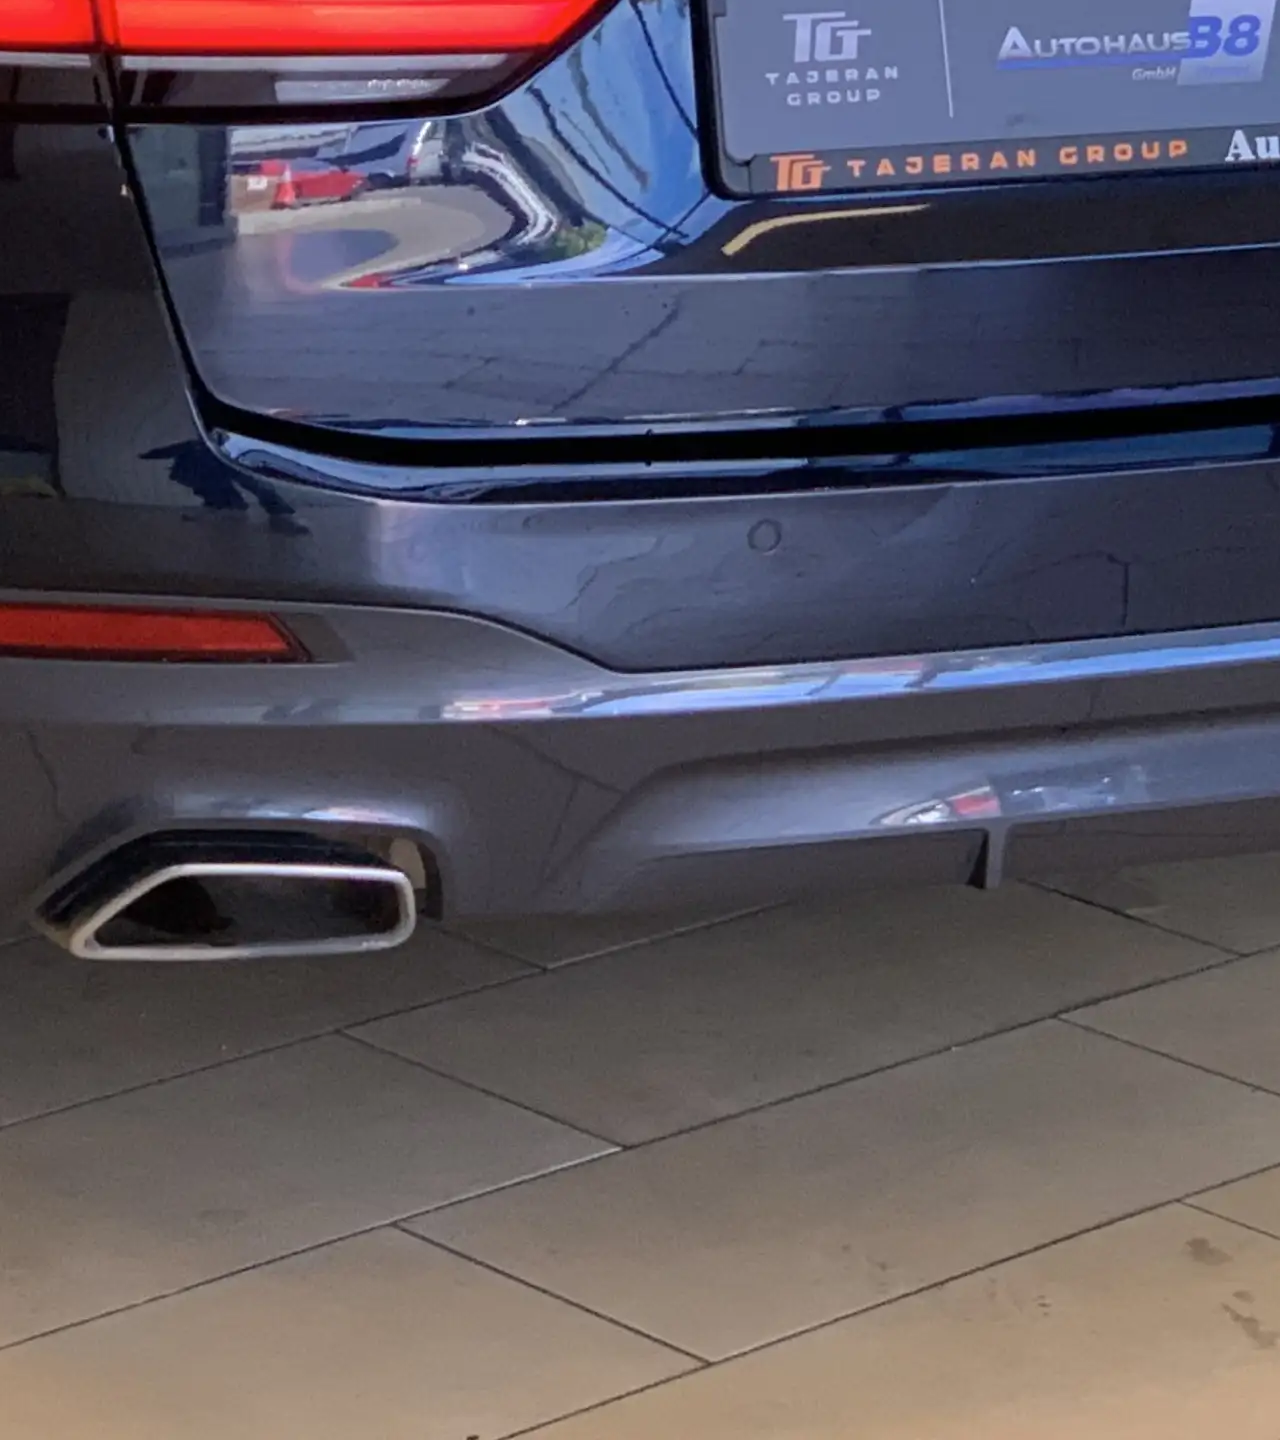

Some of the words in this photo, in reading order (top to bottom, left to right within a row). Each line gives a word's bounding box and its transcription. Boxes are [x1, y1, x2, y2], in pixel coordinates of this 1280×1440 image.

[1187, 14, 1261, 59] B8
[765, 66, 898, 85] TAJERAN
[1131, 65, 1176, 81] GmbH
[786, 89, 880, 106] GROUP
[846, 148, 1037, 178] TAJERAN
[1059, 139, 1188, 165] GROUP
